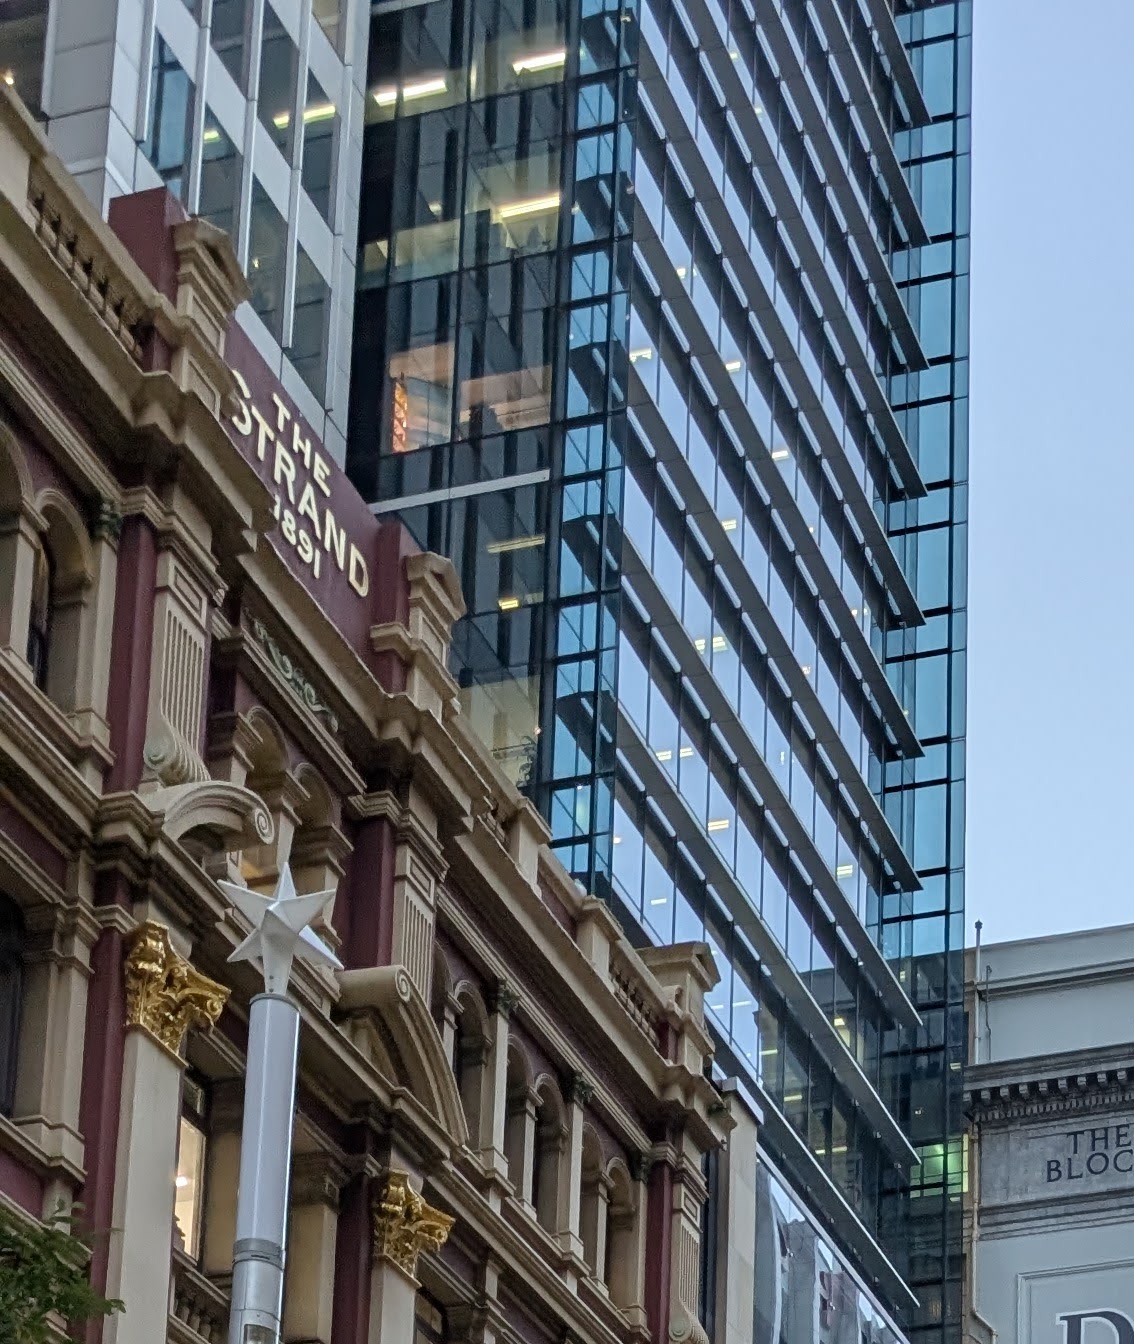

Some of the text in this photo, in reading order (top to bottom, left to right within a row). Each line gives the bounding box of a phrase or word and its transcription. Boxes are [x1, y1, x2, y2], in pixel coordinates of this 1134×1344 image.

[232, 370, 370, 597] STRAND
[272, 393, 331, 497] THE
[272, 495, 320, 579] 1891
[1067, 1124, 1131, 1154] THE
